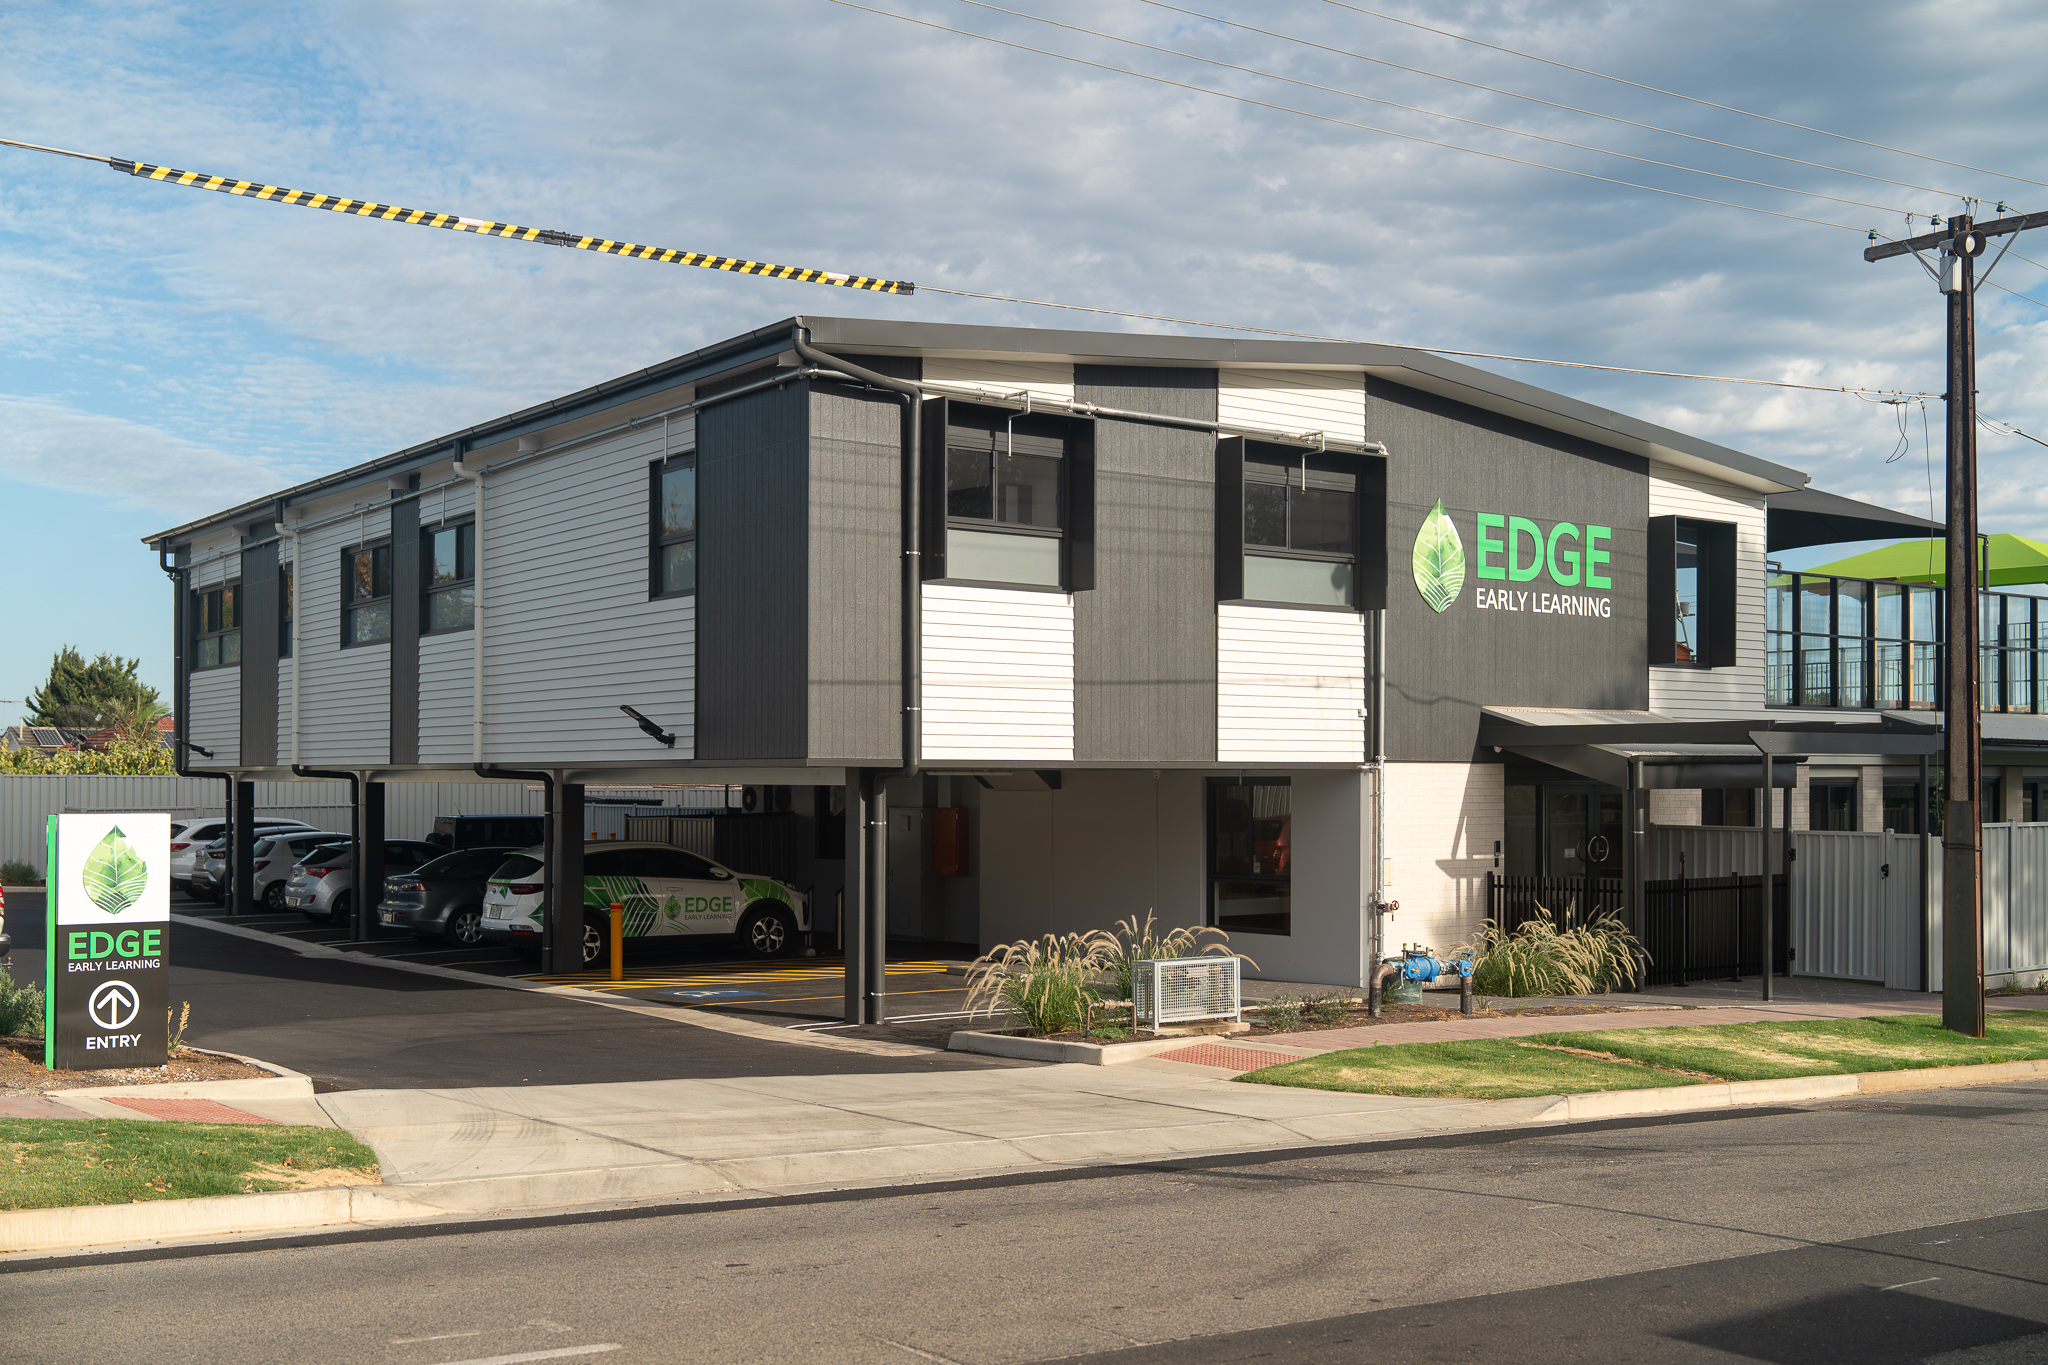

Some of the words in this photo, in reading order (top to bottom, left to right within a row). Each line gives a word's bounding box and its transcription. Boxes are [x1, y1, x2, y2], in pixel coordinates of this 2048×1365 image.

[1477, 512, 1611, 589] EDGE
[1476, 588, 1528, 611] EARLY
[1532, 592, 1611, 617] LEARNING
[685, 897, 732, 912] EDGE
[68, 929, 161, 960] EDGE
[68, 961, 102, 972] EARLY
[106, 959, 160, 970] LEARNING
[86, 1034, 141, 1050] ENTRY
